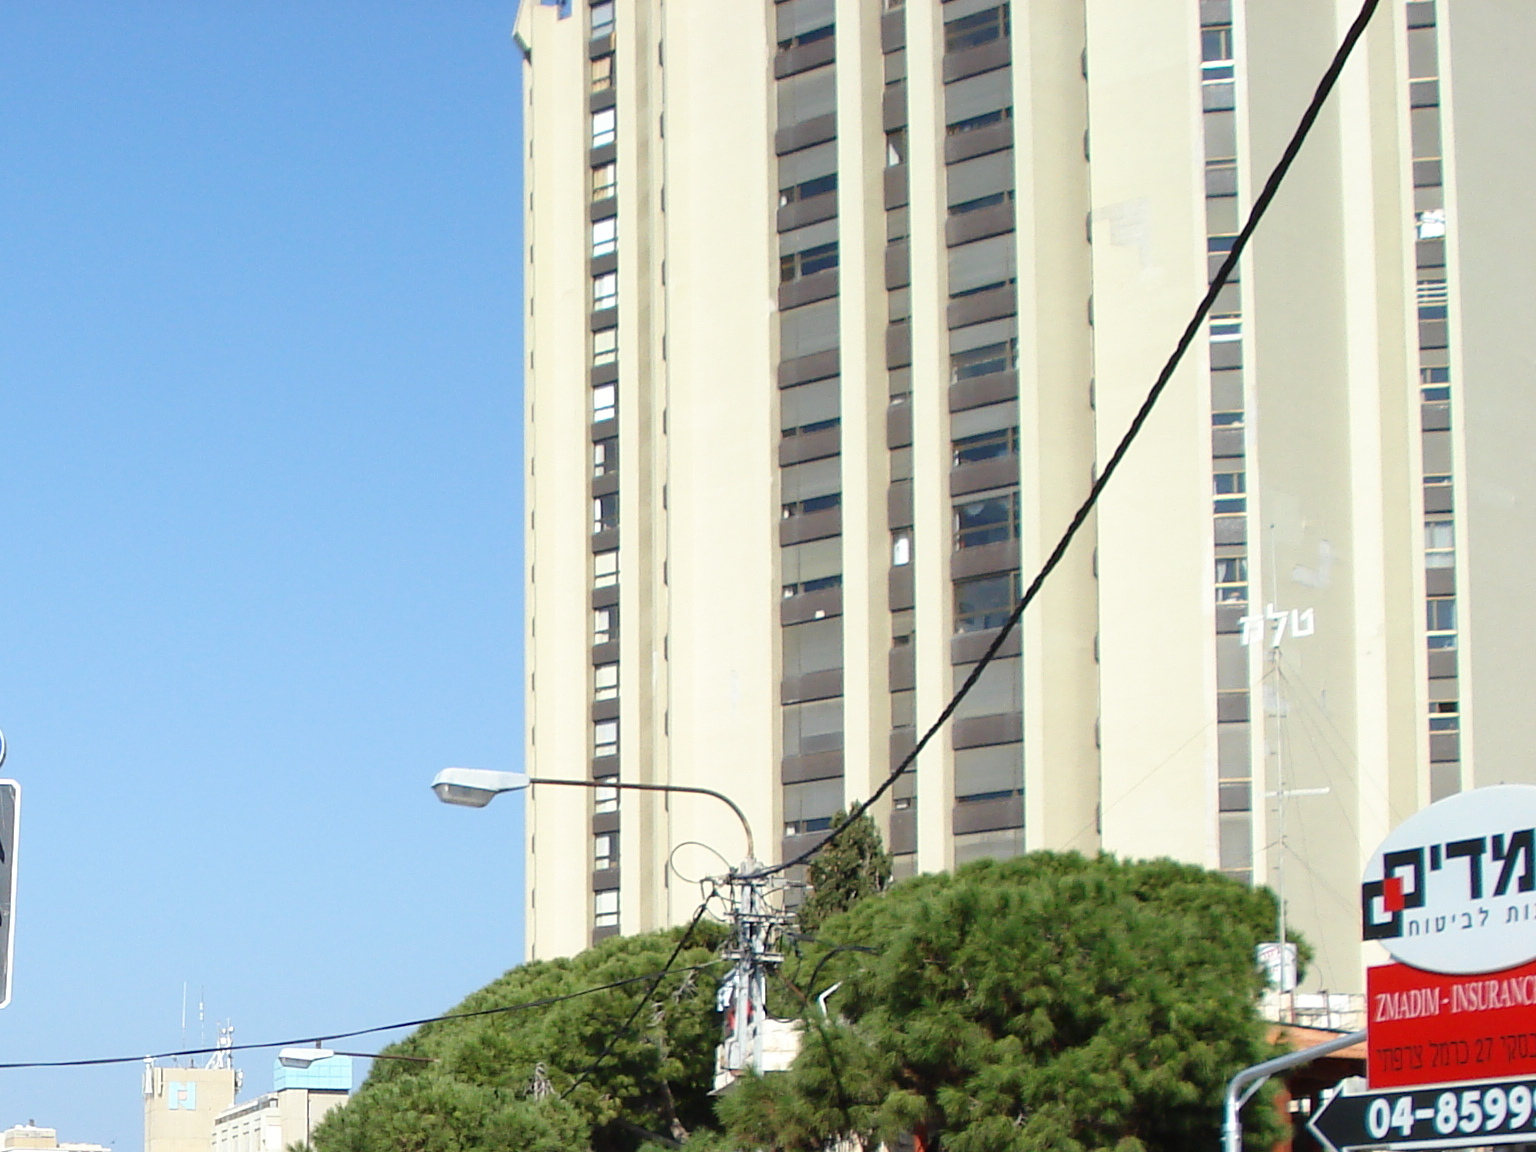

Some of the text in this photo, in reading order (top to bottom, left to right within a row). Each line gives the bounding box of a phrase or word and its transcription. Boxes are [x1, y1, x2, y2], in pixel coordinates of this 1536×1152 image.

[1408, 906, 1489, 937] לביטוח
[1374, 987, 1440, 1022] ZMADIM
[1451, 974, 1536, 1014] INSURANC
[1475, 1037, 1493, 1063] 27
[1366, 1083, 1536, 1140] 04-8599
